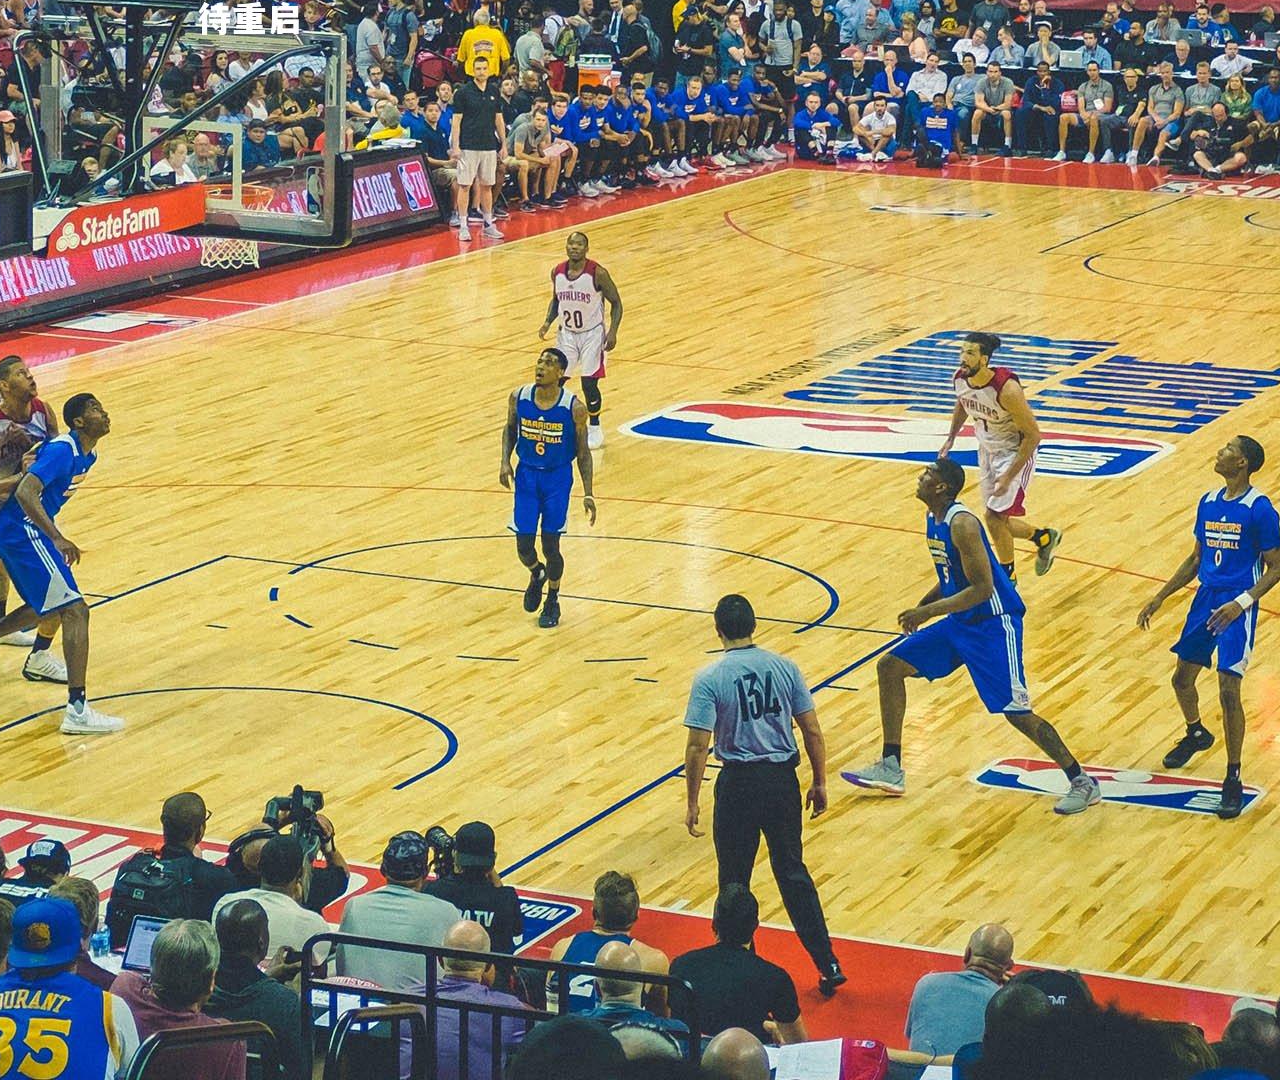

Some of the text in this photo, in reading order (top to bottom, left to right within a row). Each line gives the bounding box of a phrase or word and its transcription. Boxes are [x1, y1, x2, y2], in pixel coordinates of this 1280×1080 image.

[360, 172, 402, 220] LEAGUE
[16, 256, 76, 296] LEAGUE
[93, 244, 129, 271] MGM
[563, 310, 583, 329] 20
[521, 418, 563, 431] WARRIORS
[535, 442, 545, 457] 6
[1215, 550, 1222, 566] 0
[942, 566, 950, 584] 5
[734, 671, 782, 722] 134
[474, 911, 495, 927] TV
